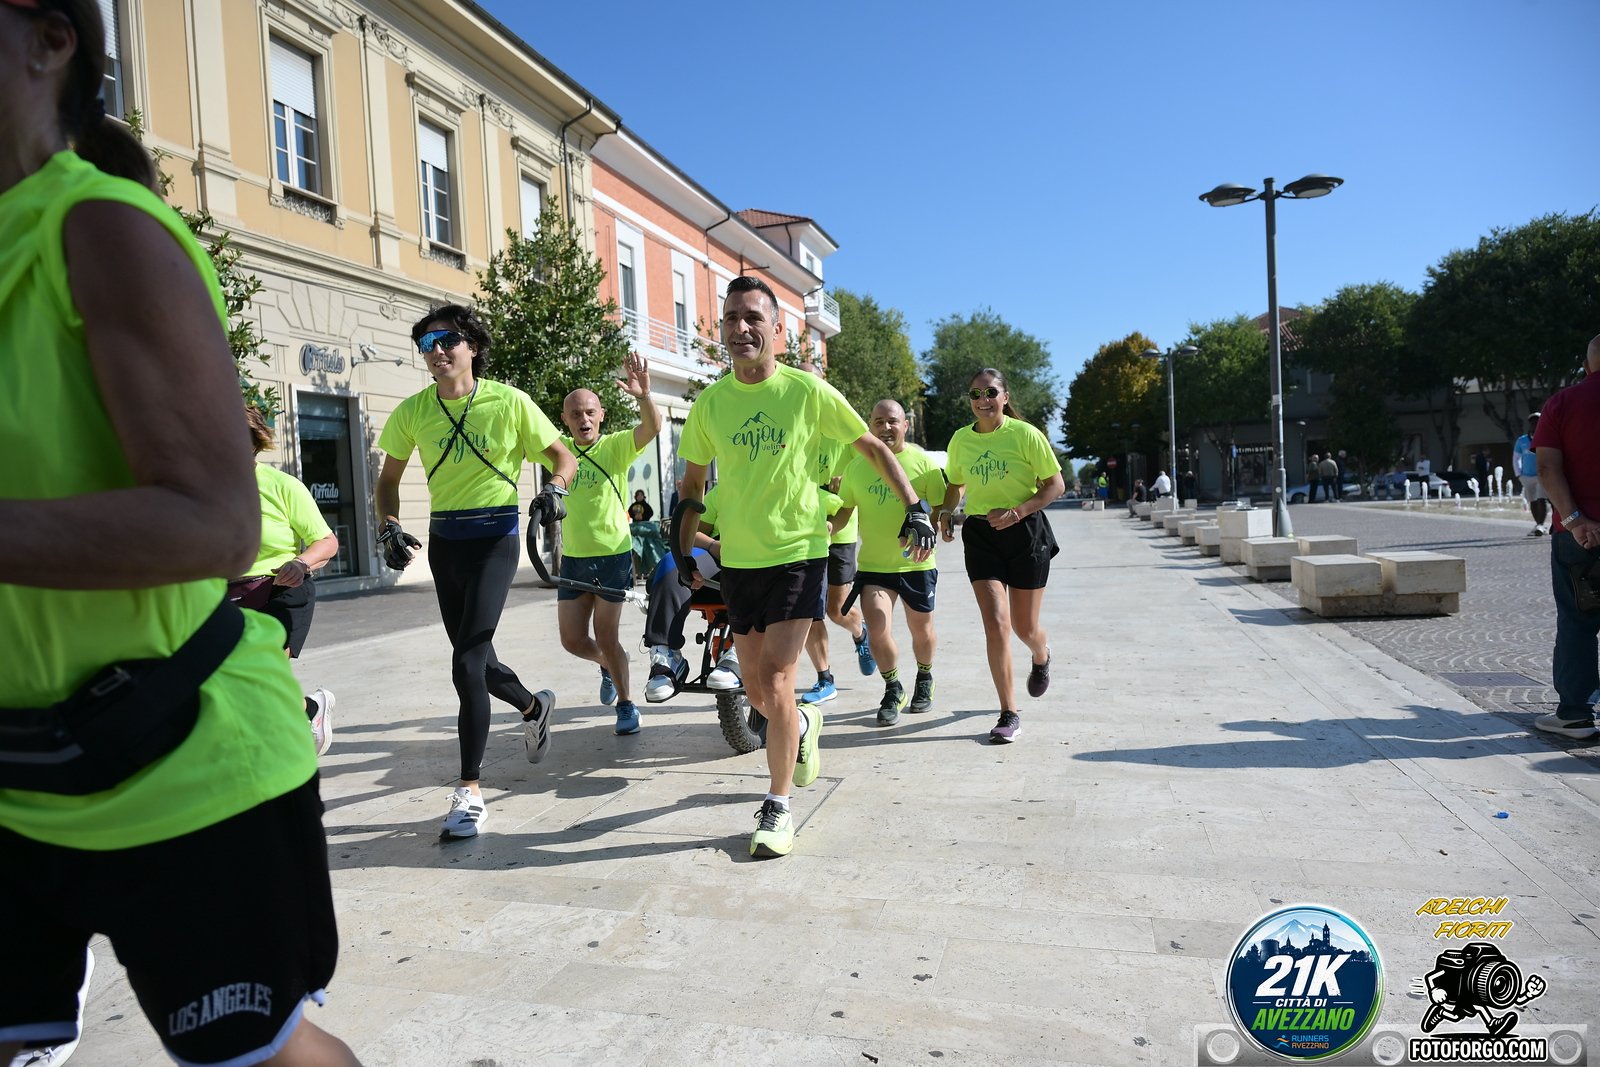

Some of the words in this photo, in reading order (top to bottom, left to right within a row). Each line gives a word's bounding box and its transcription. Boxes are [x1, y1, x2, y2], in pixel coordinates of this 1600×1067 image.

[728, 425, 787, 461] enjoy
[969, 459, 1008, 486] enjoy
[310, 482, 339, 500] Corrado
[168, 1001, 199, 1036] LOS
[200, 982, 272, 1026] ANGELES
